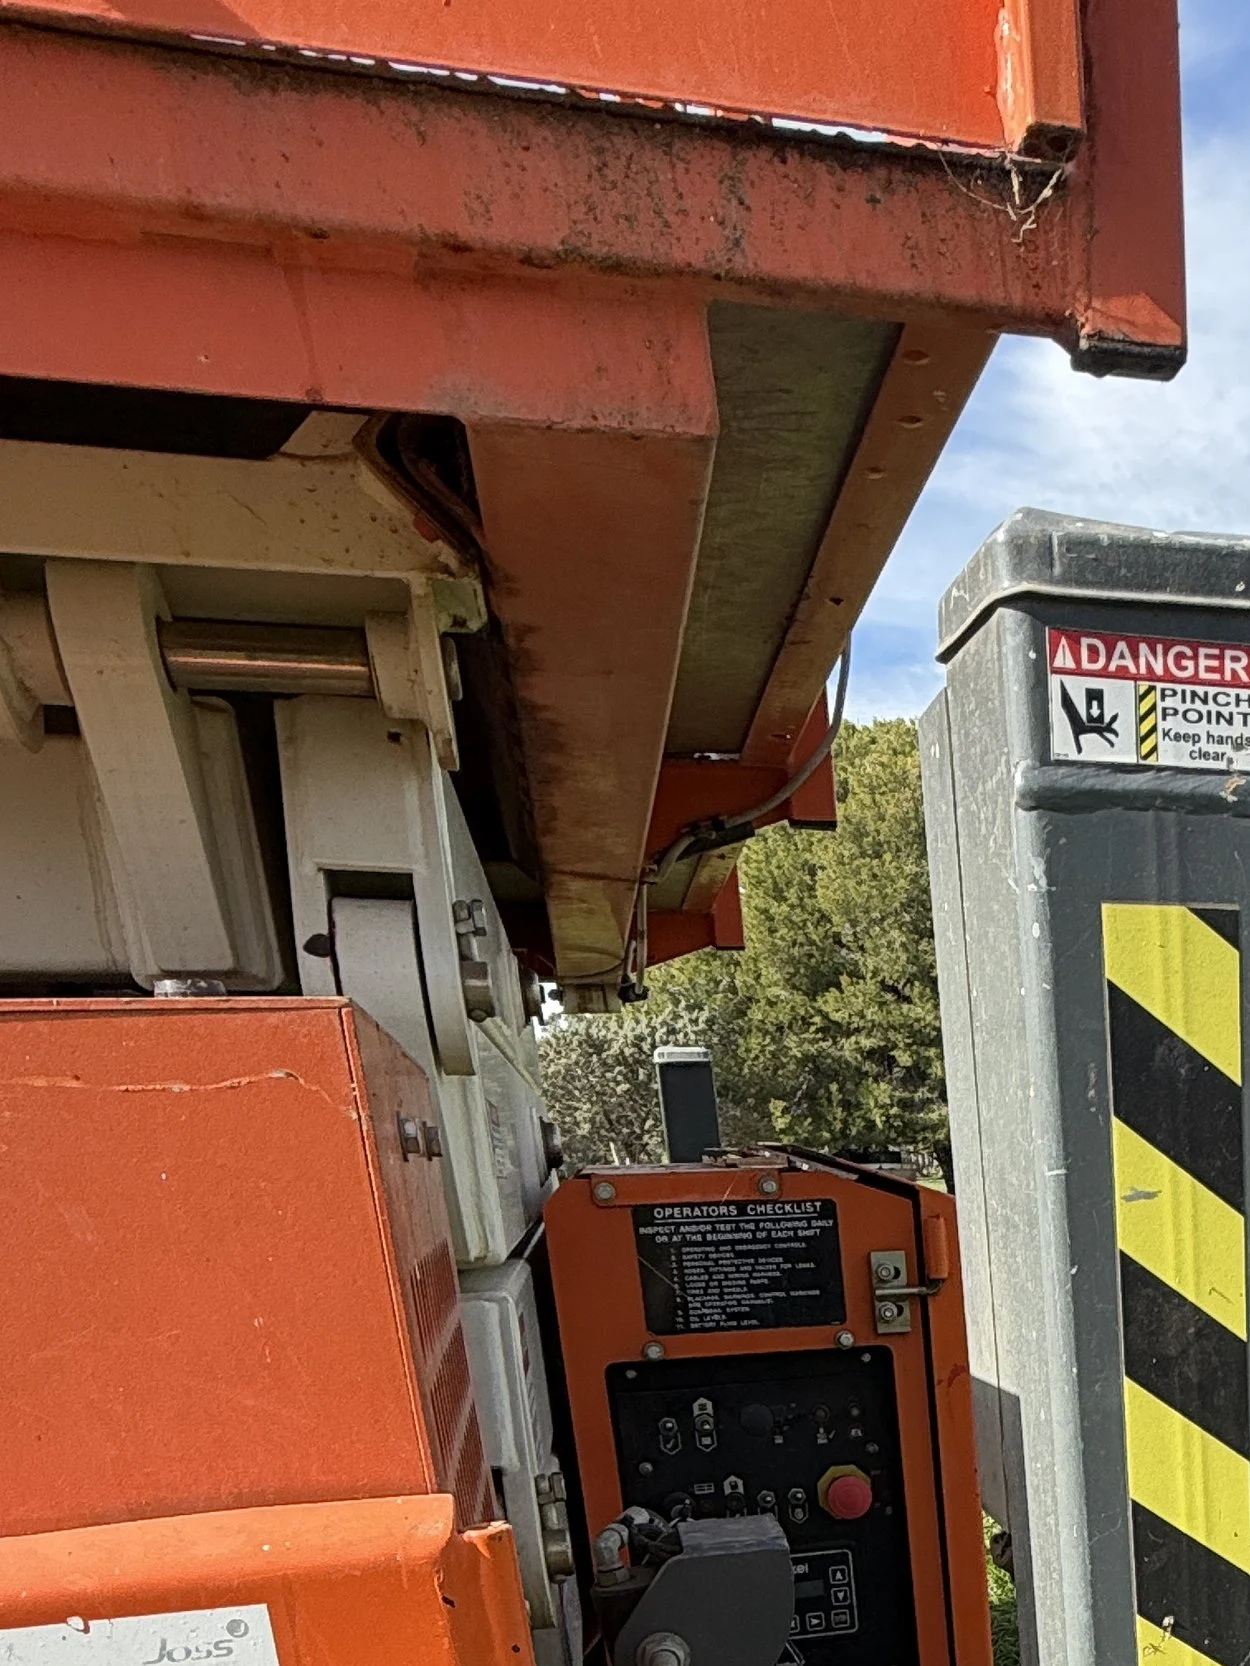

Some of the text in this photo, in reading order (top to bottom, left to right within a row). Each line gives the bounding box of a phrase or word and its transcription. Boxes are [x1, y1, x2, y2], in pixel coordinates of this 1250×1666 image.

[1080, 637, 1250, 682] DANGER
[1162, 728, 1201, 746] Keep
[653, 1201, 822, 1219] OPERATORS CHECKLIST
[714, 1223, 736, 1231] TEST
[739, 1222, 756, 1230] THE
[655, 1235, 669, 1243] OR
[671, 1234, 683, 1242] AT
[685, 1233, 703, 1242] THE
[756, 1230, 768, 1239] OF
[771, 1229, 795, 1238] EACH
